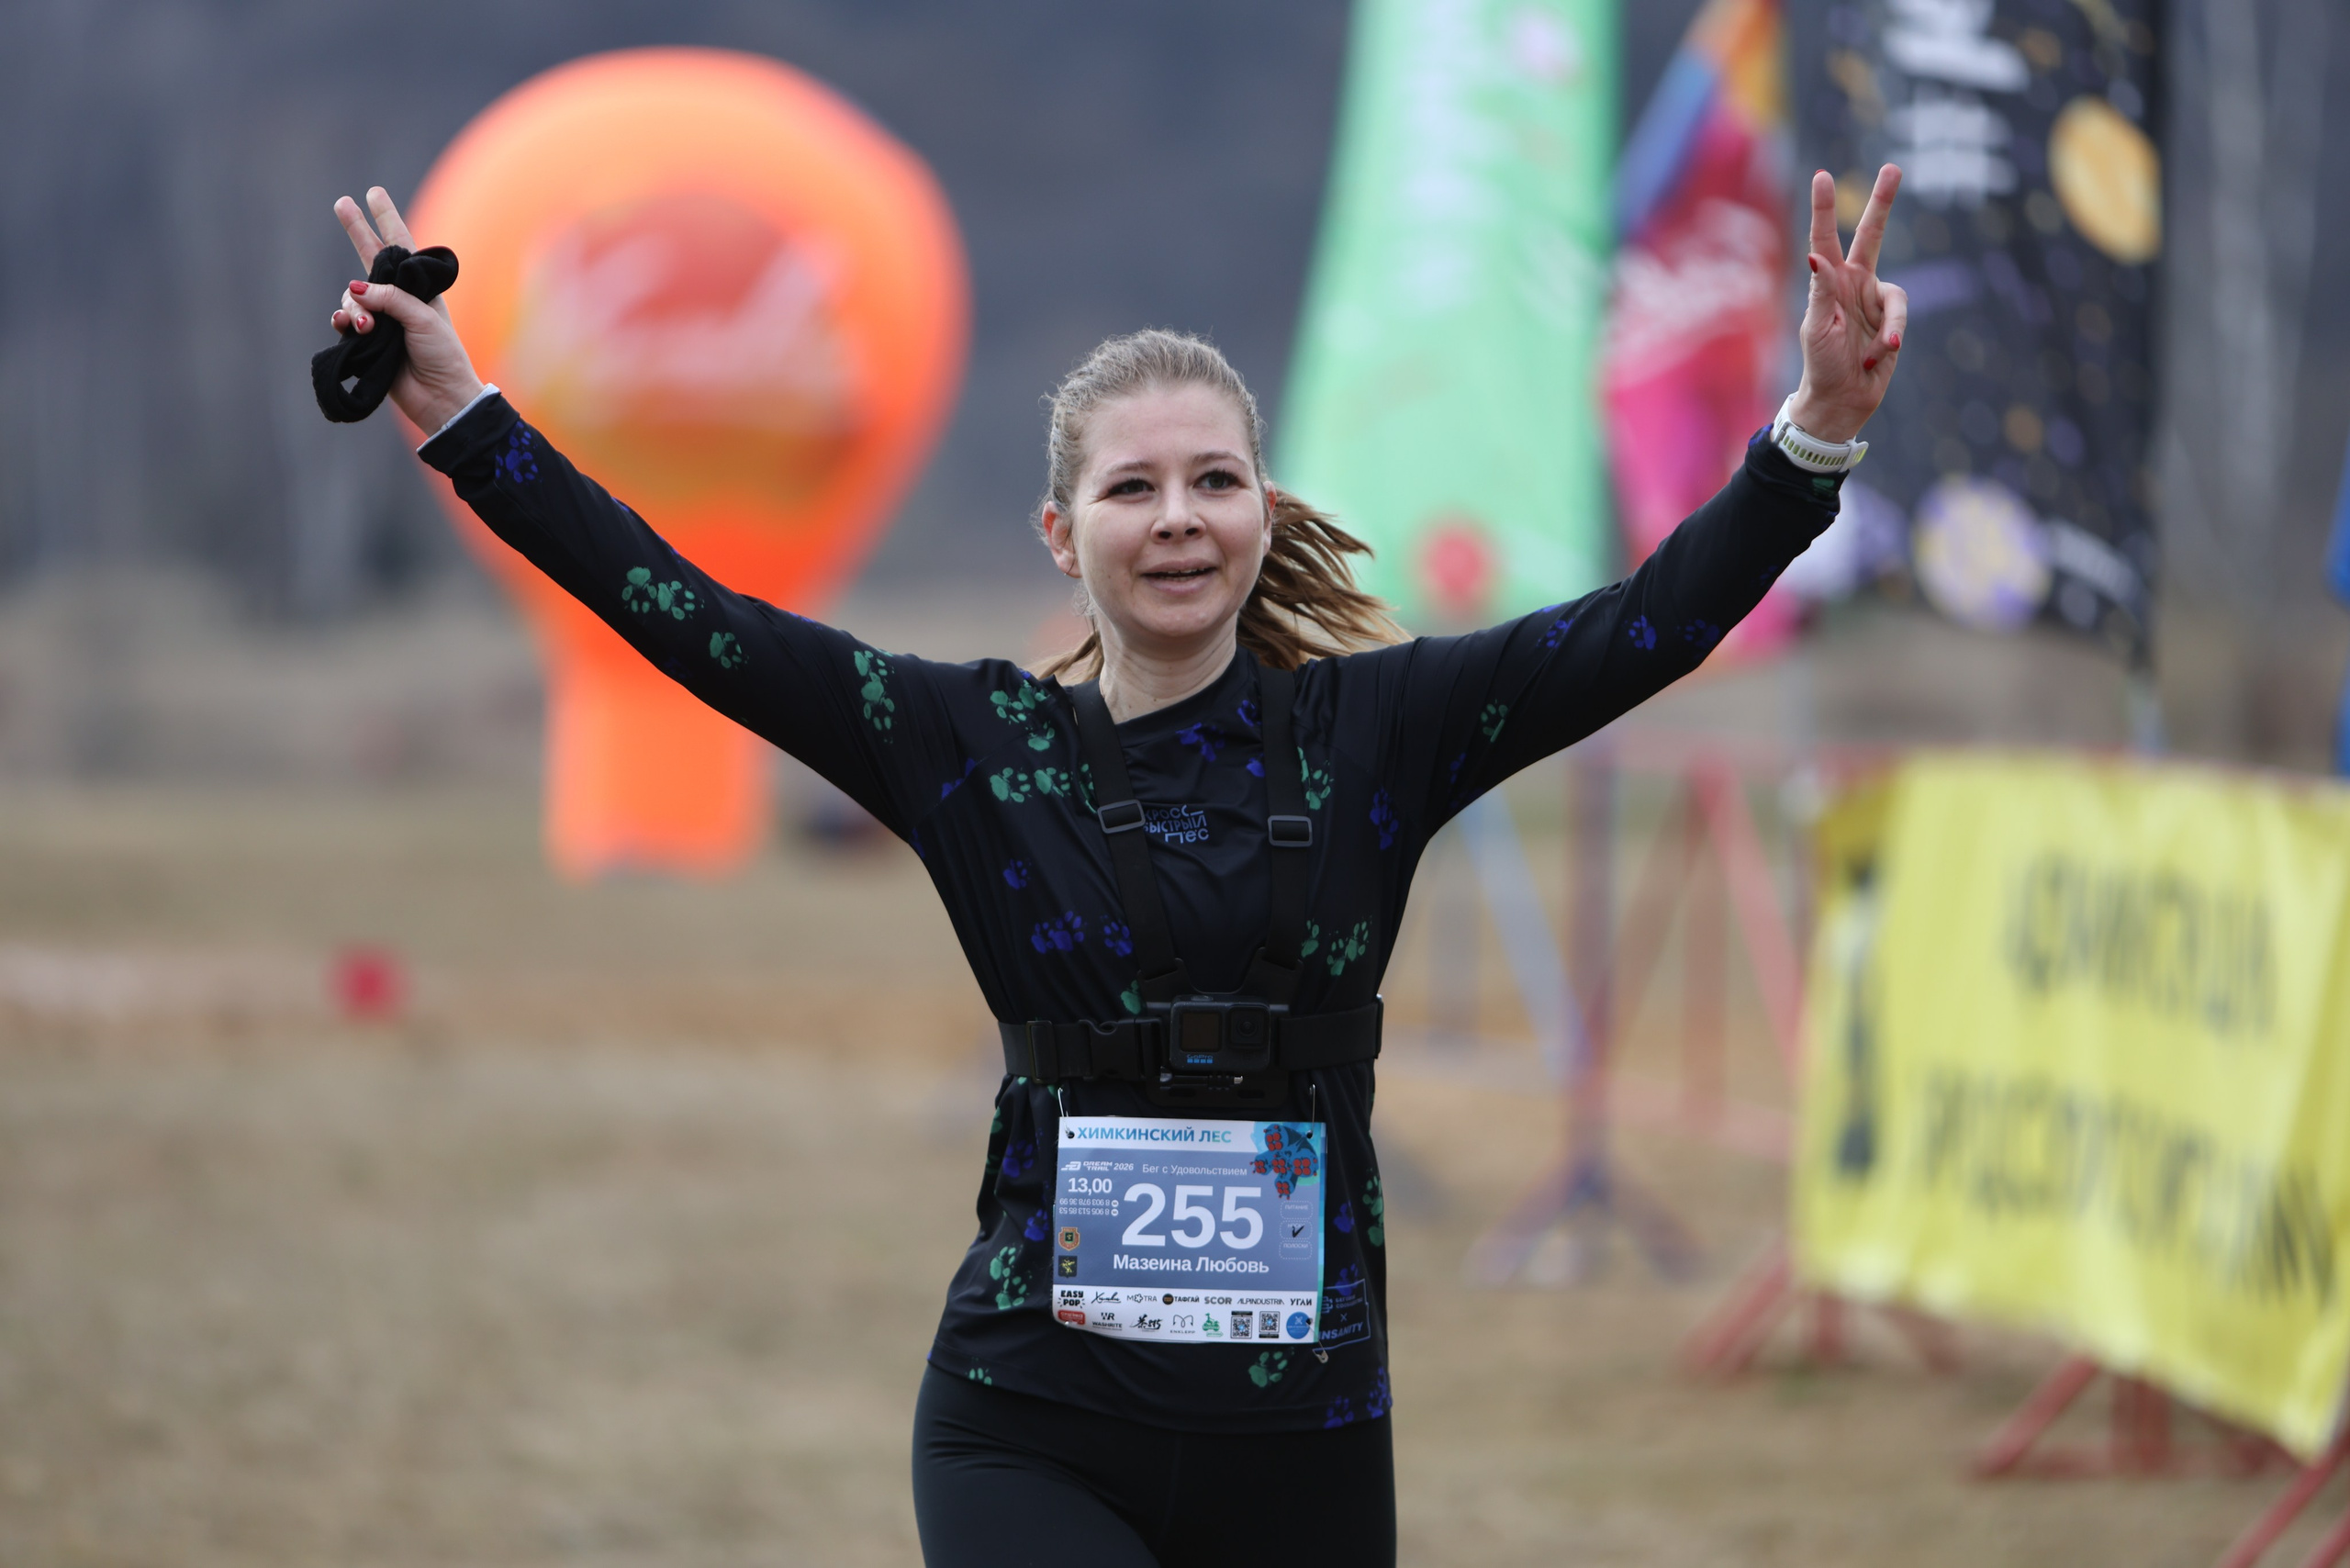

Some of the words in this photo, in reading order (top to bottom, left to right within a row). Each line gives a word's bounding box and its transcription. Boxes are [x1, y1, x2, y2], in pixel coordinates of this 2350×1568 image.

[1077, 1126, 1194, 1142] ХИМКИНСКИЙ
[1199, 1130, 1232, 1143] ЛЕС
[1113, 1162, 1135, 1171] 2026
[1142, 1164, 1159, 1175] Бег
[1170, 1165, 1248, 1176] Удовольствием
[1068, 1177, 1113, 1196] 13,00
[1122, 1182, 1264, 1250] 255
[1113, 1254, 1192, 1271] Мазеина
[1195, 1256, 1270, 1273] Любовь
[1060, 1290, 1084, 1298] EASY
[1173, 1294, 1200, 1303] ТАФГАЙ
[1063, 1298, 1080, 1306] POP
[1203, 1296, 1232, 1305] SCOR
[1237, 1297, 1285, 1305] ALPINDUSTRIA
